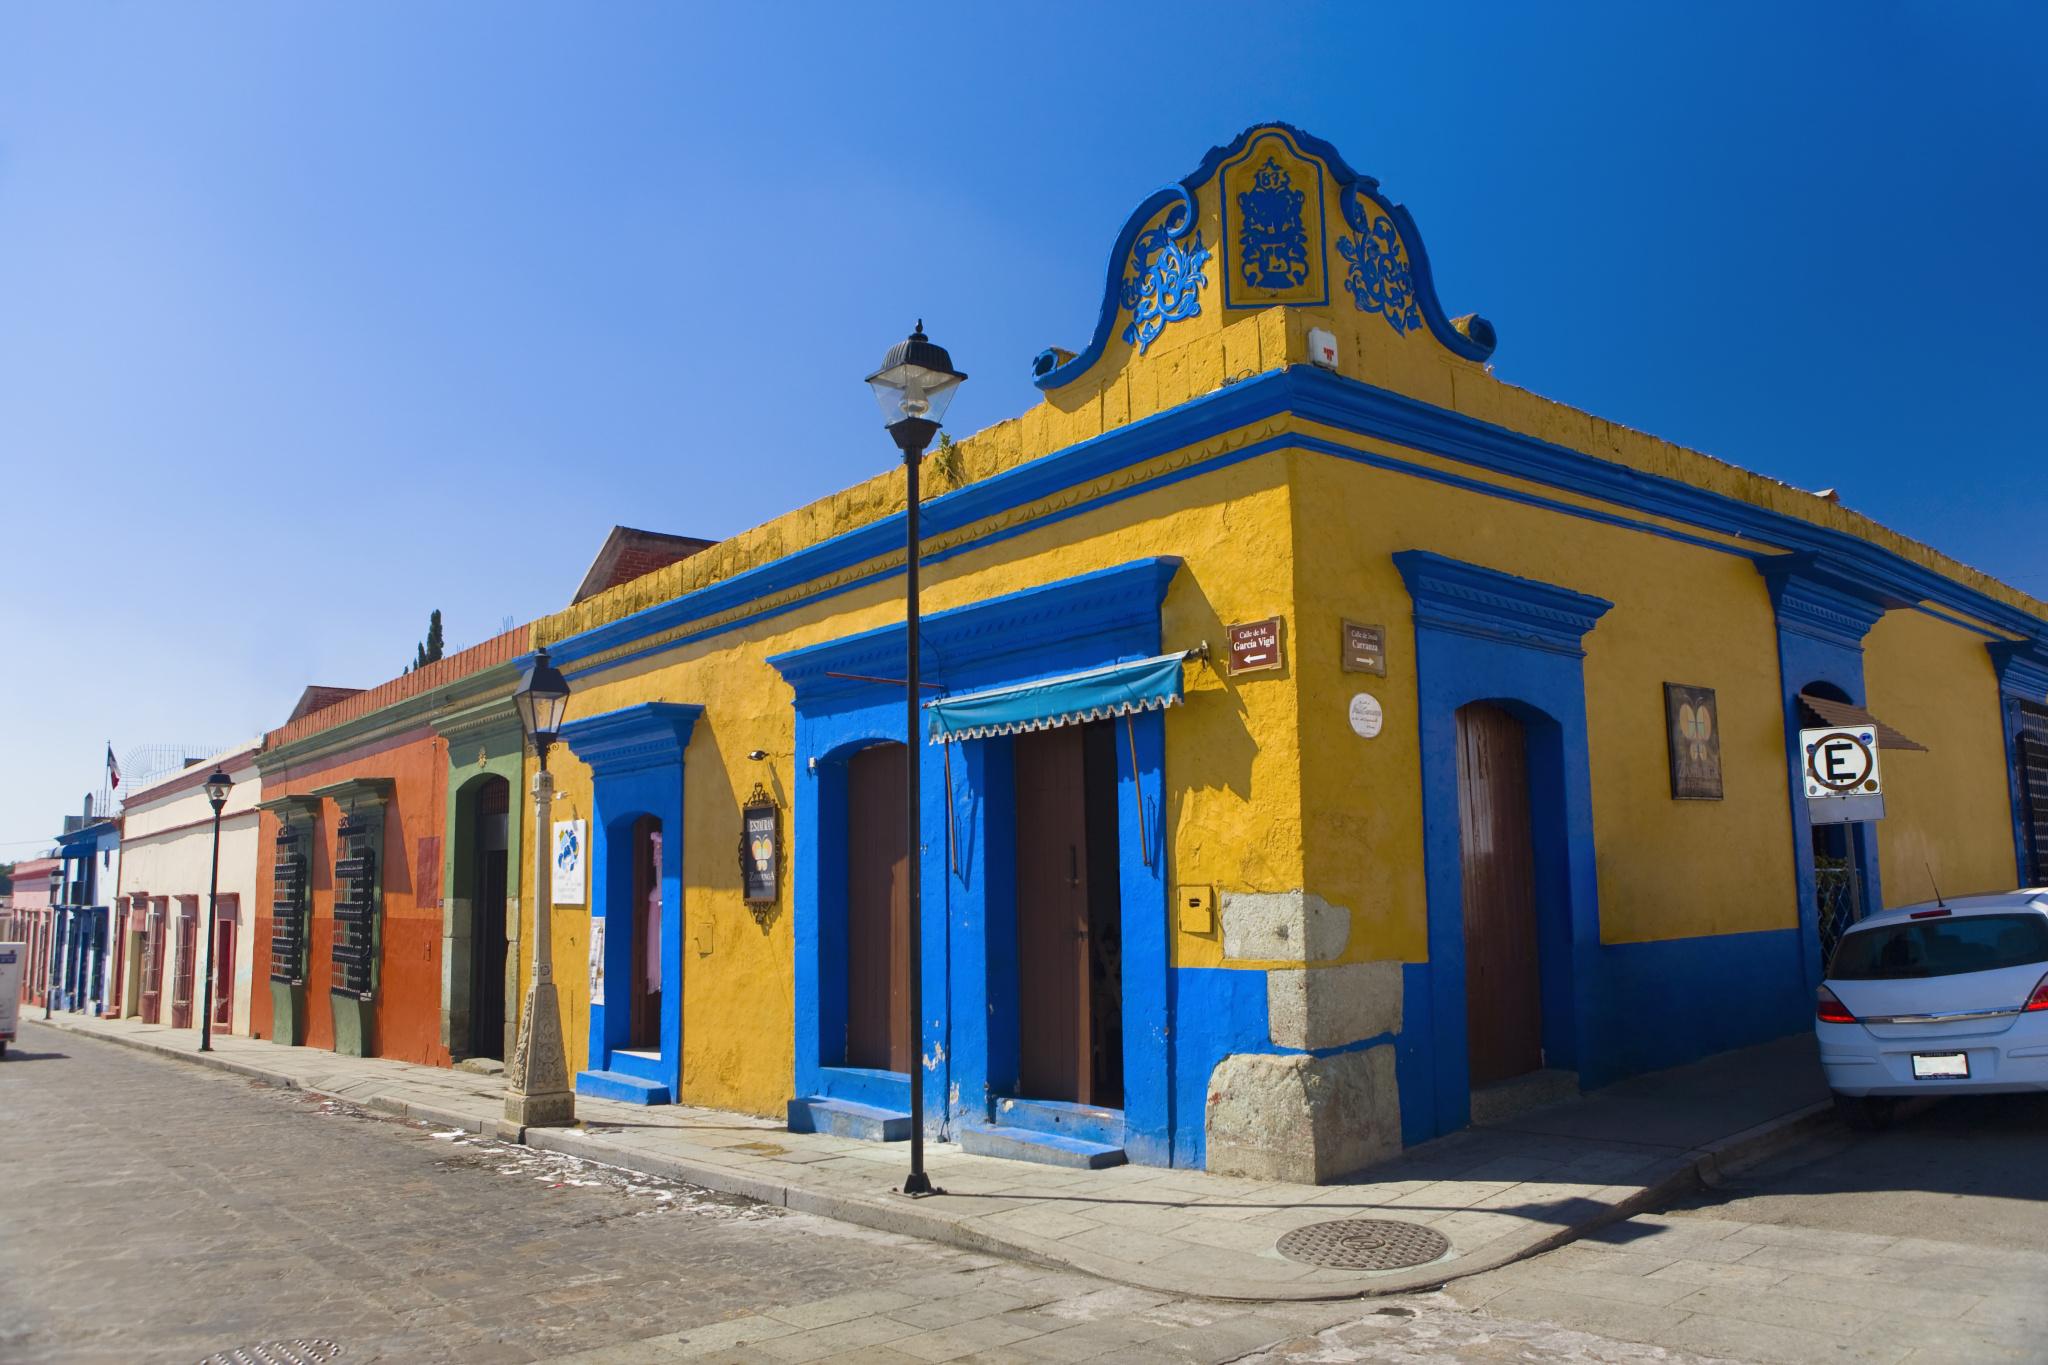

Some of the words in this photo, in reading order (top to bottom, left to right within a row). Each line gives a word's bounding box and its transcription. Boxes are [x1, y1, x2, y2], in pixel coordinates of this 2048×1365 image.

[1239, 630, 1253, 639] Calle
[1253, 629, 1260, 637] de
[1260, 627, 1268, 635] M.
[1351, 629, 1362, 638] Calle
[1233, 638, 1256, 651] García
[1258, 635, 1275, 648] Vigil
[1352, 639, 1379, 652] Carranza
[1825, 743, 1857, 780] E
